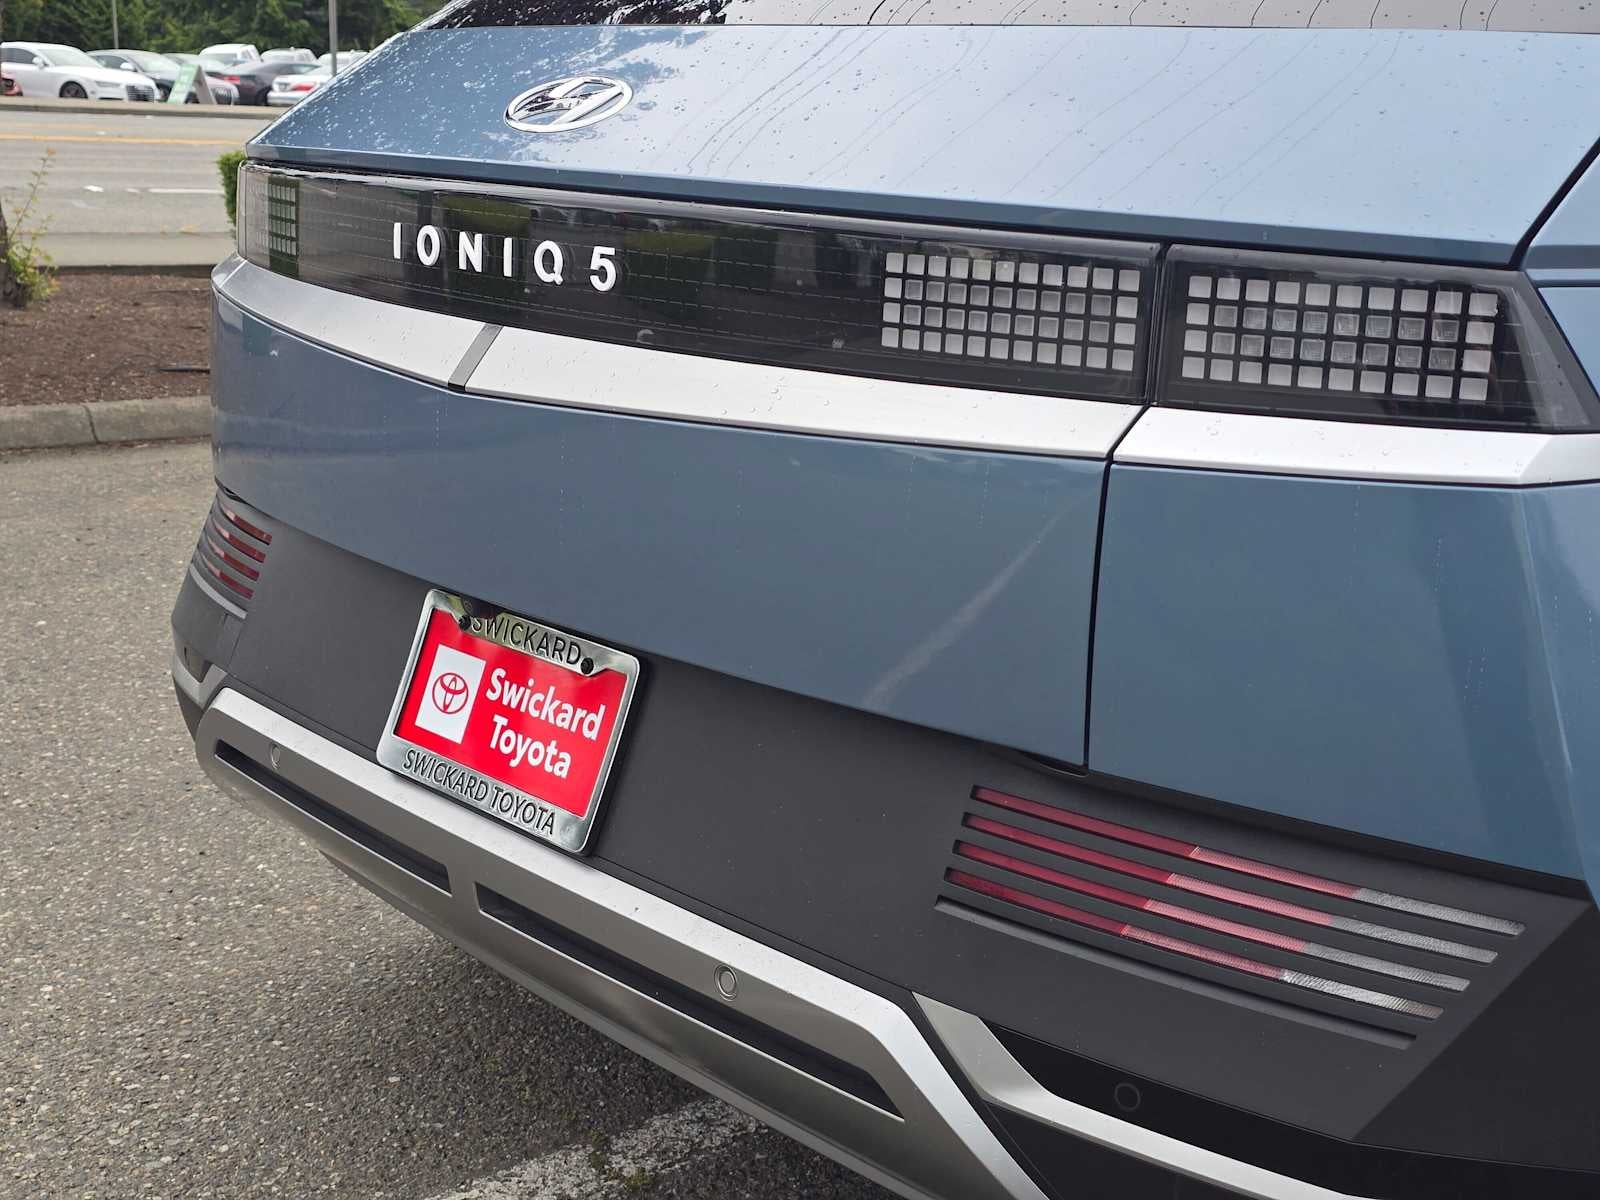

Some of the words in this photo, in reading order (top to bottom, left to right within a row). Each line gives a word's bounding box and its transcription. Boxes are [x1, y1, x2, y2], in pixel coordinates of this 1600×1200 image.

[393, 222, 564, 285] IONIQ
[589, 246, 617, 292] 5
[470, 615, 582, 666] SWICKARD
[485, 667, 606, 741] Swickard
[489, 715, 572, 778] Toyota
[403, 749, 489, 802] SWICKARD
[491, 786, 555, 835] TOYOTA
